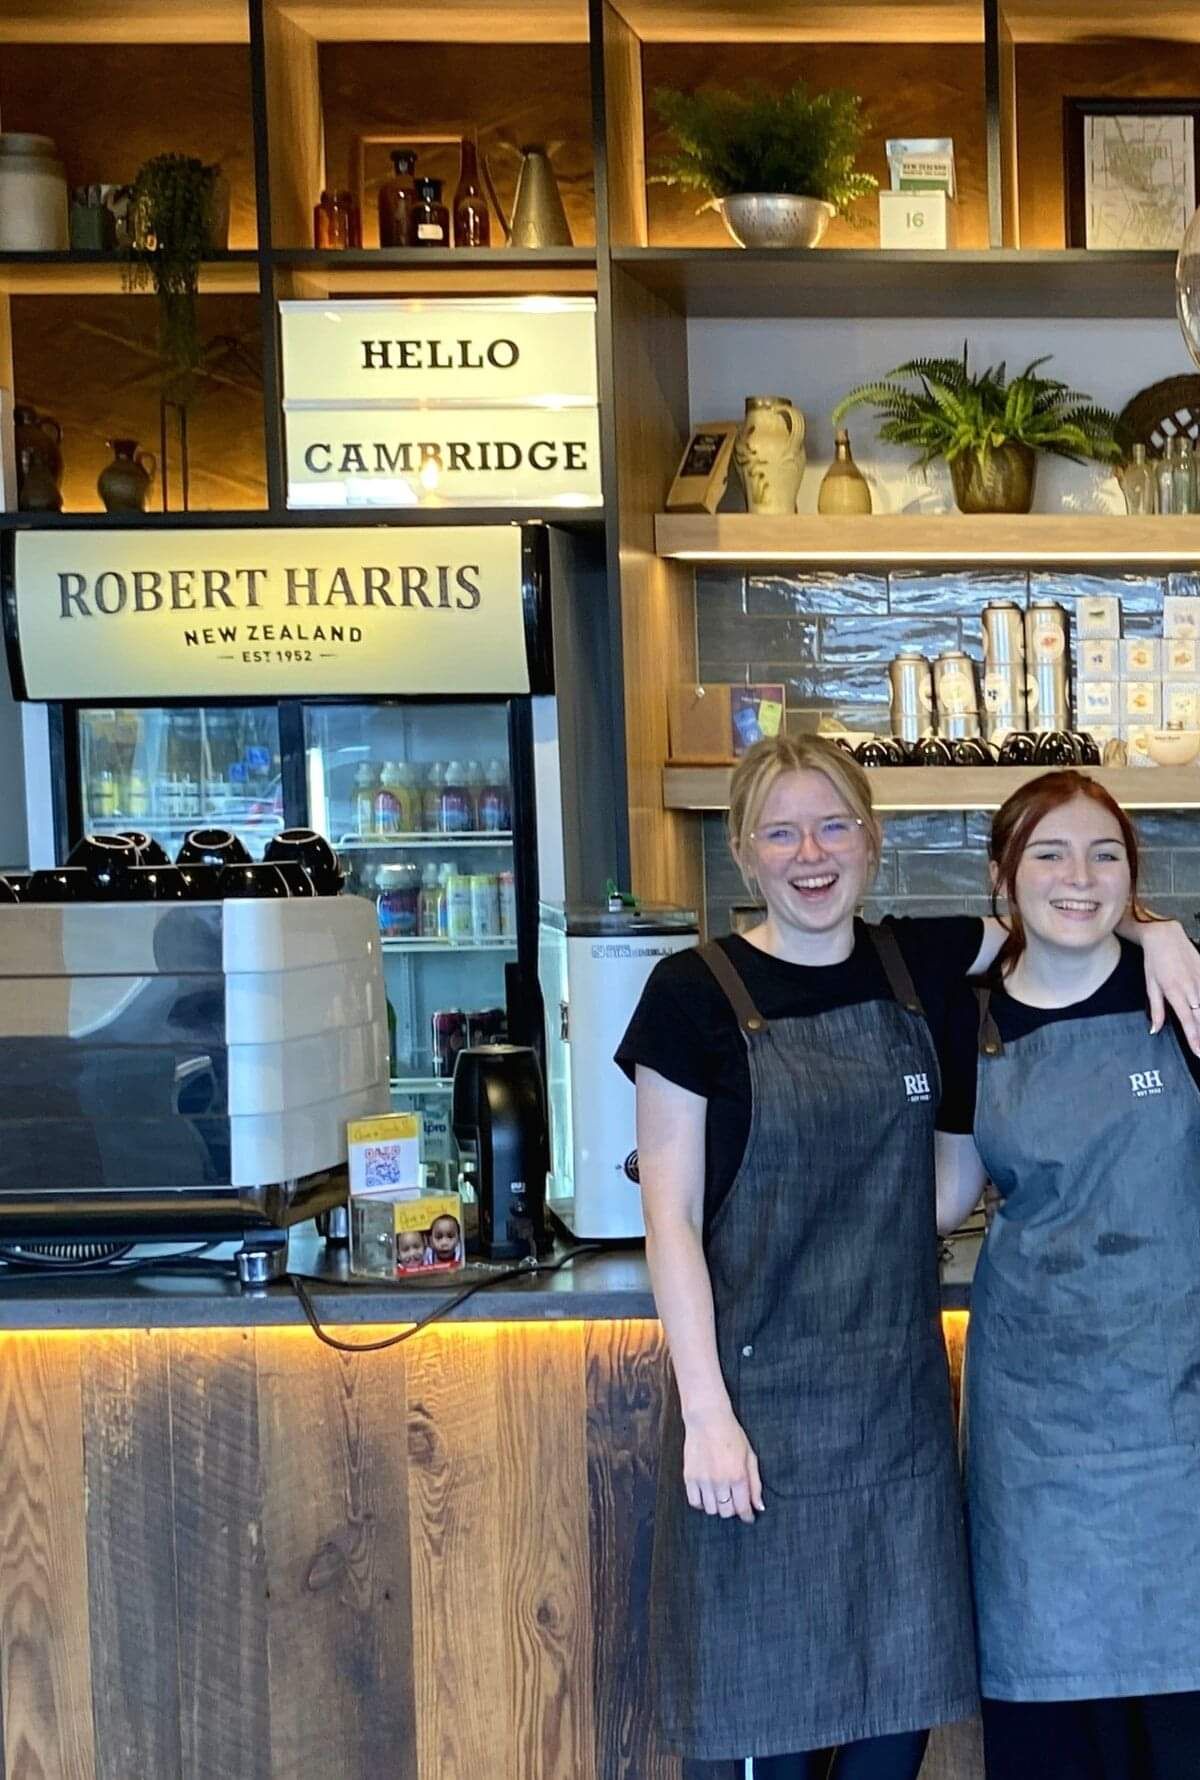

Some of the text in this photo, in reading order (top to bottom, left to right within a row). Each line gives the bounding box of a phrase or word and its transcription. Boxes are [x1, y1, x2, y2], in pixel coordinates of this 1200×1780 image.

[906, 211, 925, 229] 16
[360, 338, 521, 369] HELLO
[303, 440, 588, 474] CAMBRIDGE
[57, 563, 482, 618] ROBERT HARRIS
[184, 624, 363, 647] NEW ZEALAND
[276, 649, 313, 662] 1952
[903, 1072, 931, 1096] RH
[1129, 1069, 1164, 1092] RH
